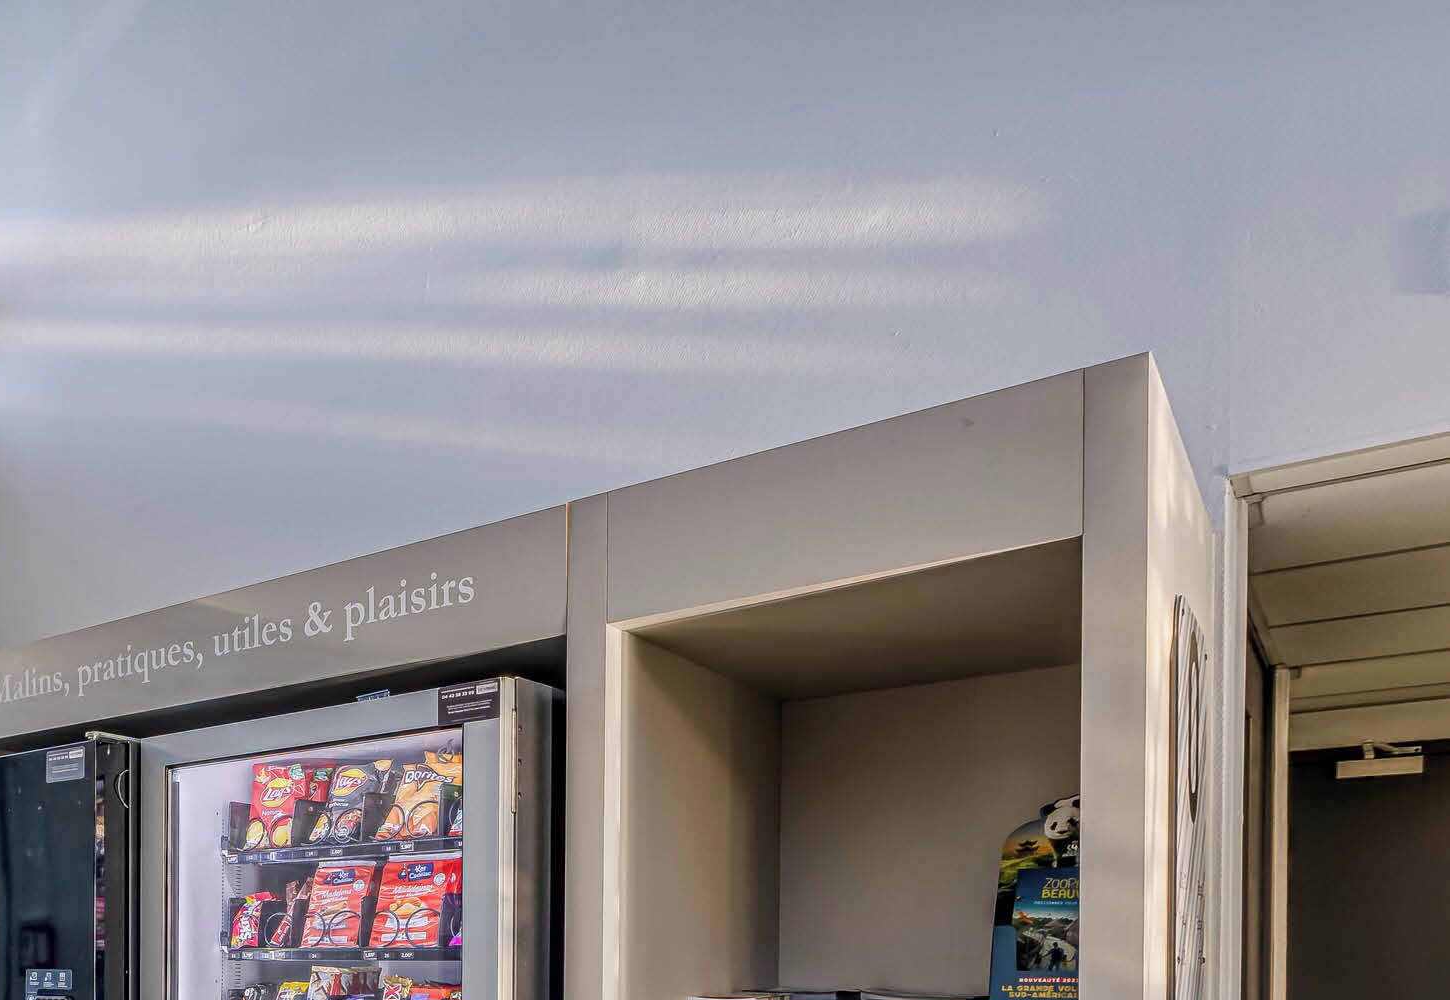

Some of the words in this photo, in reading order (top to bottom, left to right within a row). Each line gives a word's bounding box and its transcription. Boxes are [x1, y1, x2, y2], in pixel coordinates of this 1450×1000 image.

[77, 639, 203, 697] pratiques,
[213, 614, 292, 657] utiles
[304, 602, 333, 638] &
[344, 571, 475, 641] plaisirs
[404, 769, 454, 784] Doritos
